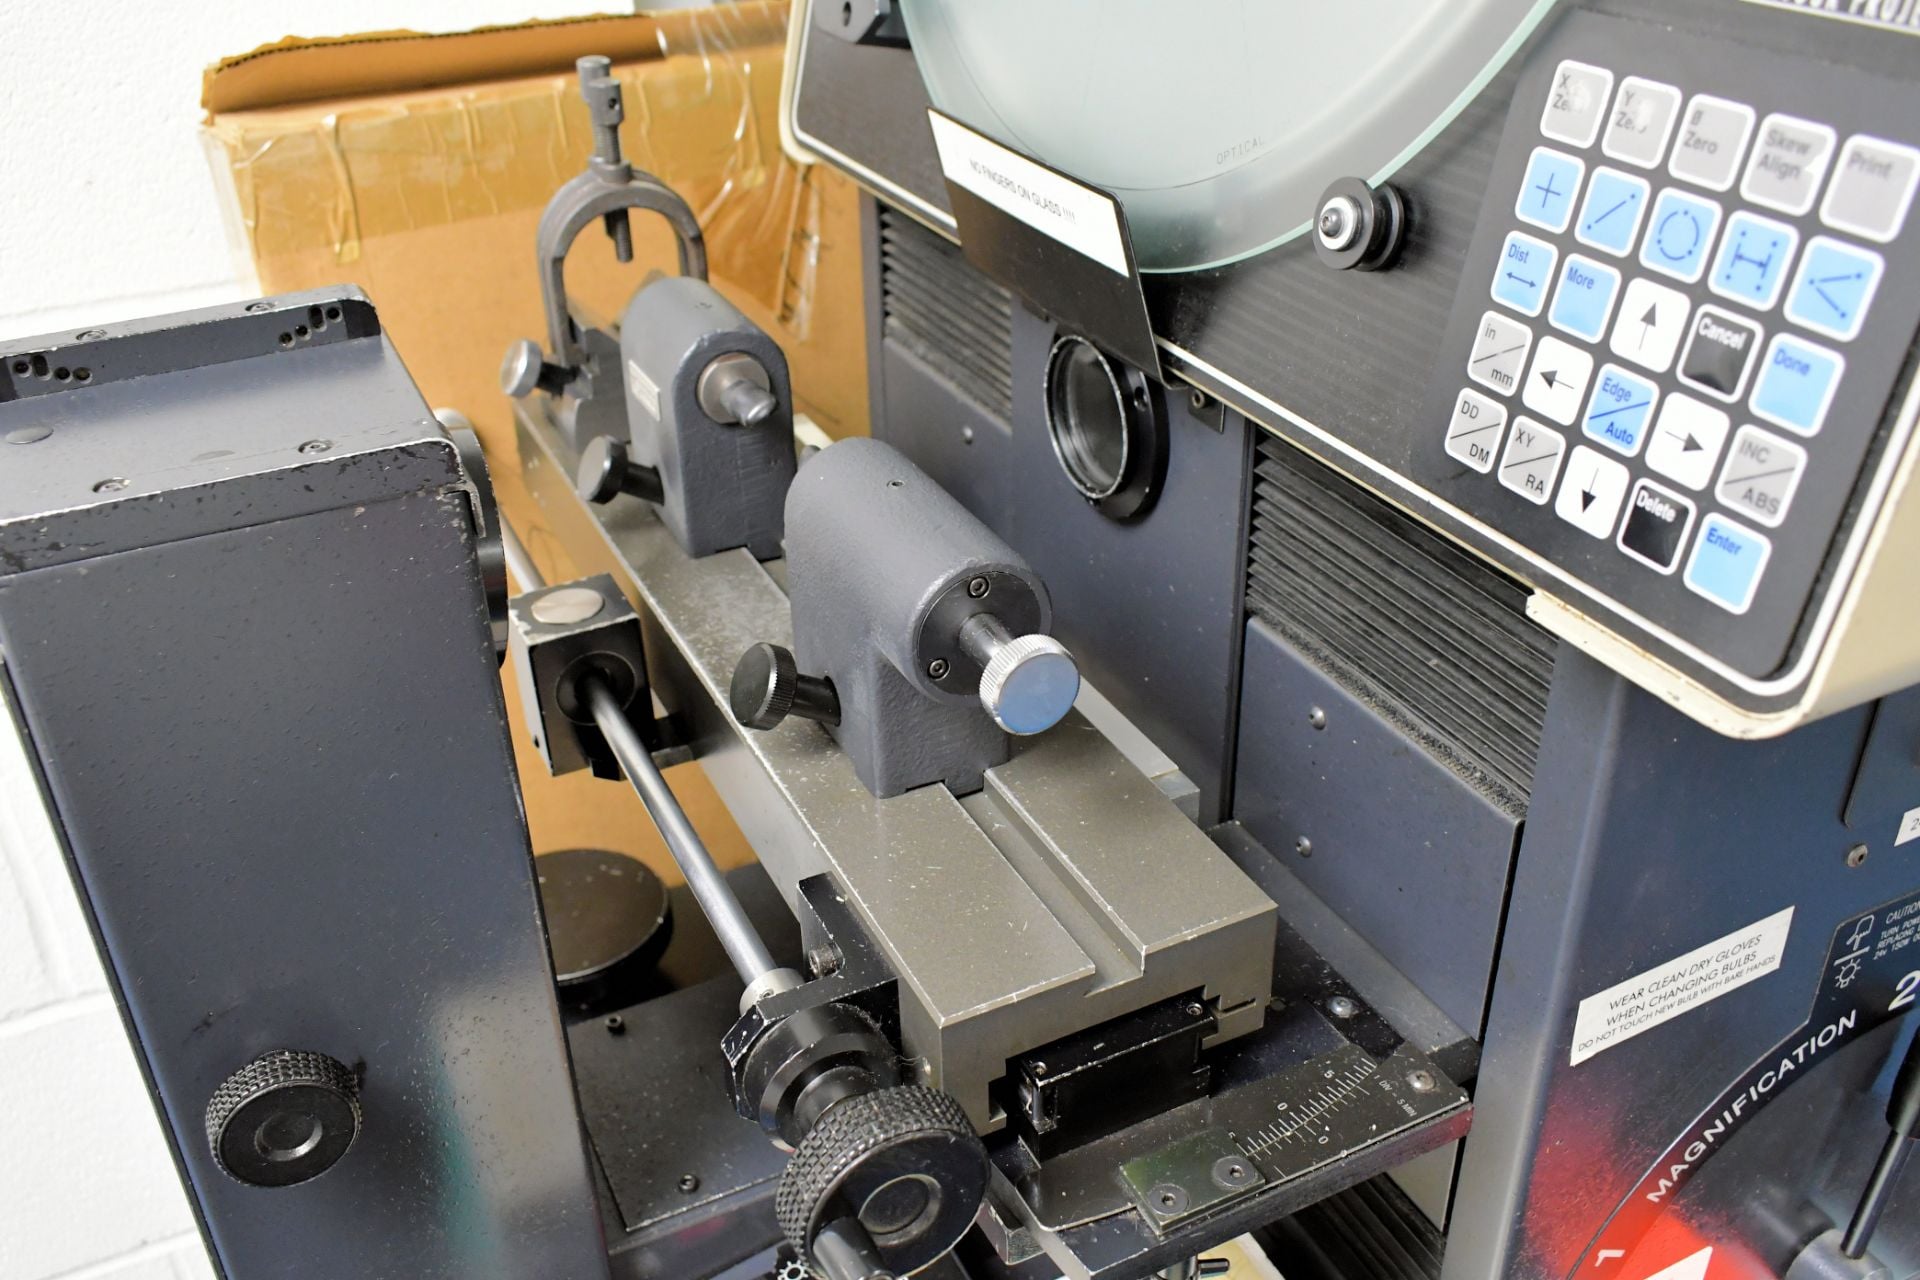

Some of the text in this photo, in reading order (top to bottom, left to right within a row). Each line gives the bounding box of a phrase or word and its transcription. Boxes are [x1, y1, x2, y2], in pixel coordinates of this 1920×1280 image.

[1559, 74, 1571, 89] X
[1624, 91, 1635, 106] Y
[1217, 136, 1264, 165] OPTICAL
[1683, 131, 1719, 155] Zero
[1758, 153, 1801, 181] Align
[1849, 151, 1894, 179] Print
[1017, 185, 1030, 200] ON
[1031, 193, 1061, 216] GLASS
[1507, 243, 1530, 264] Dist
[1566, 266, 1595, 290] More
[1484, 324, 1496, 341] in
[1698, 317, 1747, 351] Cancel
[1773, 347, 1810, 377] Done
[1490, 367, 1514, 387] mm
[1602, 376, 1632, 402] Edge
[1461, 401, 1480, 419] DD
[1515, 428, 1536, 448] XY
[1605, 421, 1634, 445] Auto
[1469, 443, 1490, 464] DM
[1737, 439, 1772, 466] INC
[1525, 474, 1544, 494] RA
[1636, 490, 1676, 523] Delete
[1741, 485, 1780, 517] ABS
[1706, 527, 1742, 556] Enter
[1609, 934, 1762, 1011] WEAR CLEAN DRY GLOVES
[1607, 951, 1757, 1027] WHEN CHANGING BULBS
[1578, 955, 1776, 1053] DO NOT TOUCH NEW BULB WITH BARE HANDS
[1646, 1009, 1857, 1204] MAGNIFICATION
